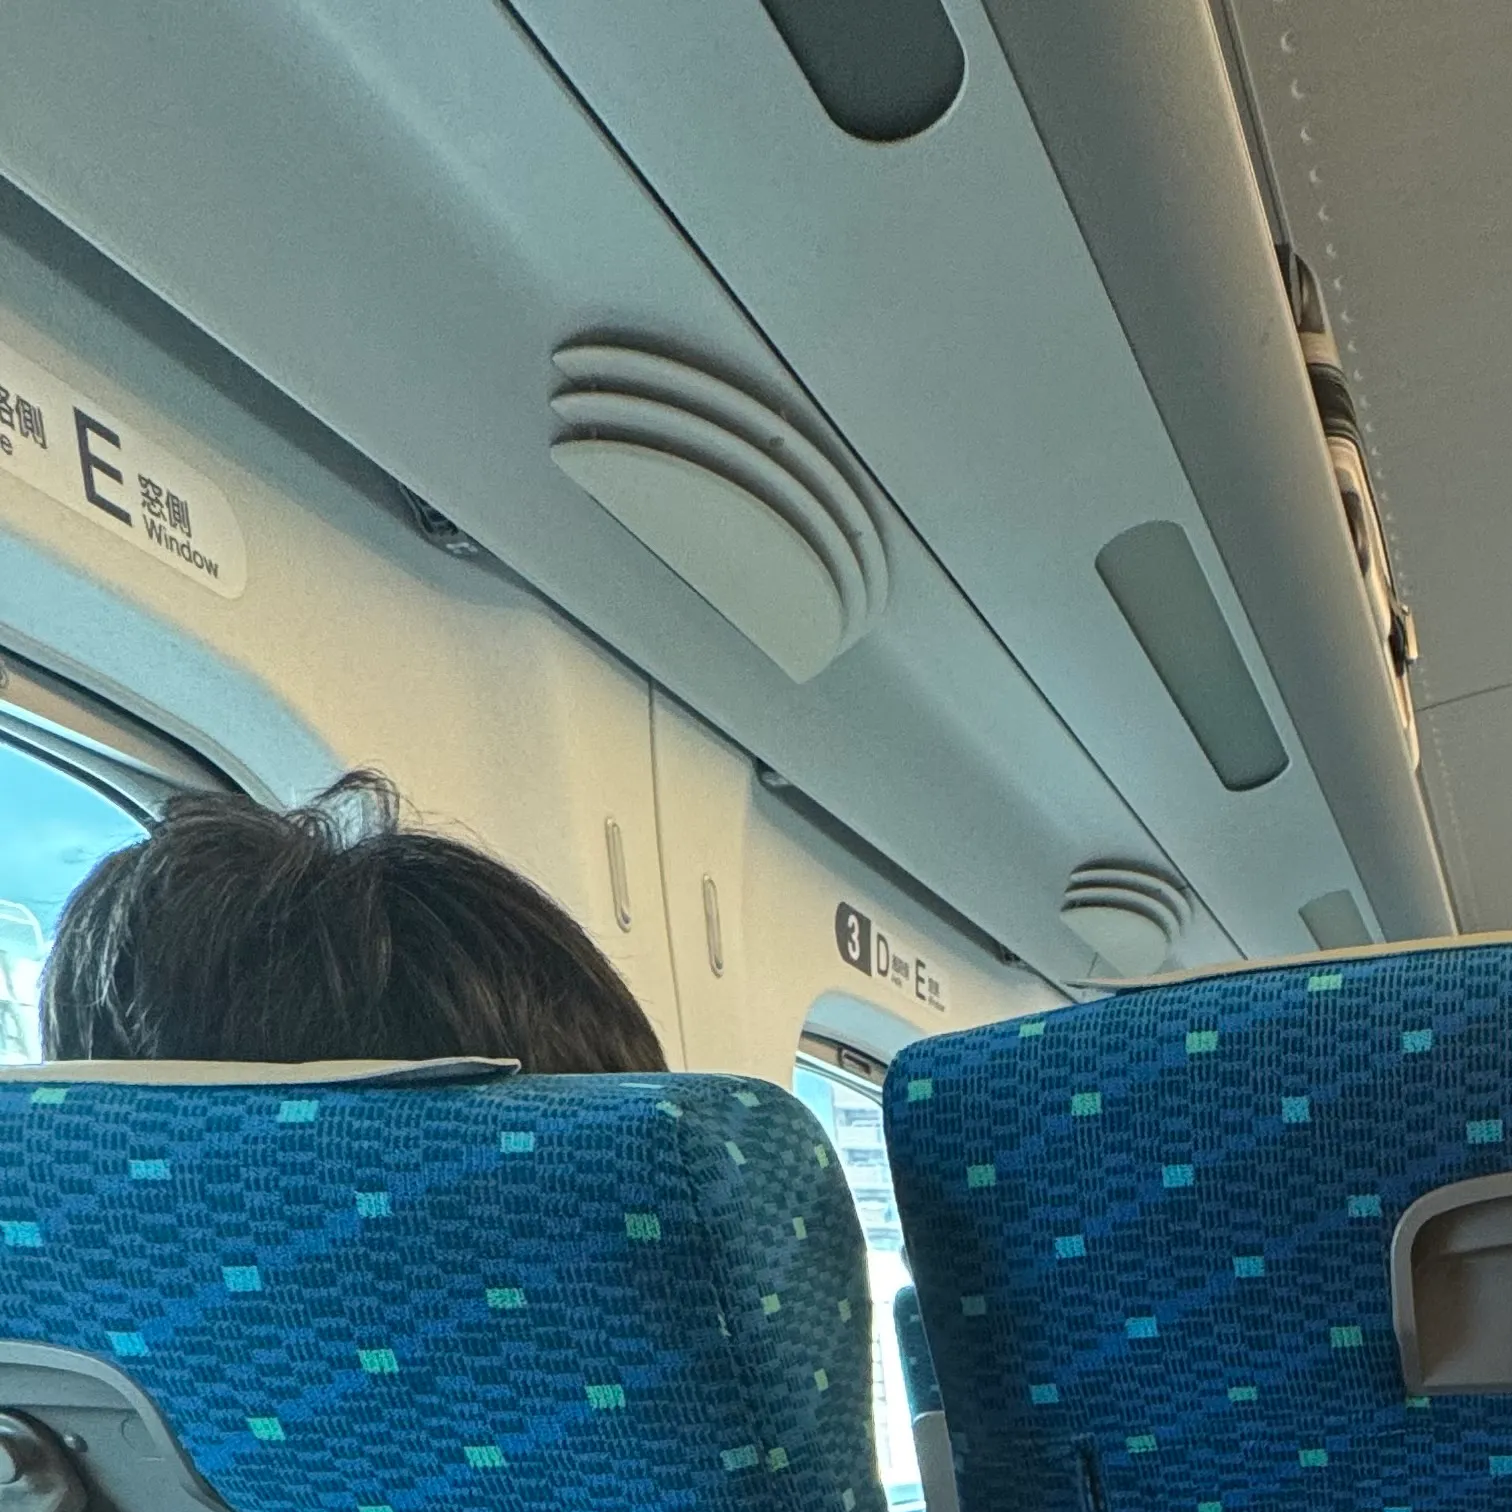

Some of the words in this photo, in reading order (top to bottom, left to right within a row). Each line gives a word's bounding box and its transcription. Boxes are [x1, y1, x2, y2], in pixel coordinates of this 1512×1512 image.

[73, 405, 133, 528] E
[138, 473, 192, 538] 窓側
[143, 514, 219, 579] Window
[847, 914, 861, 961] 3
[876, 932, 889, 977] D
[916, 957, 926, 1000] E
